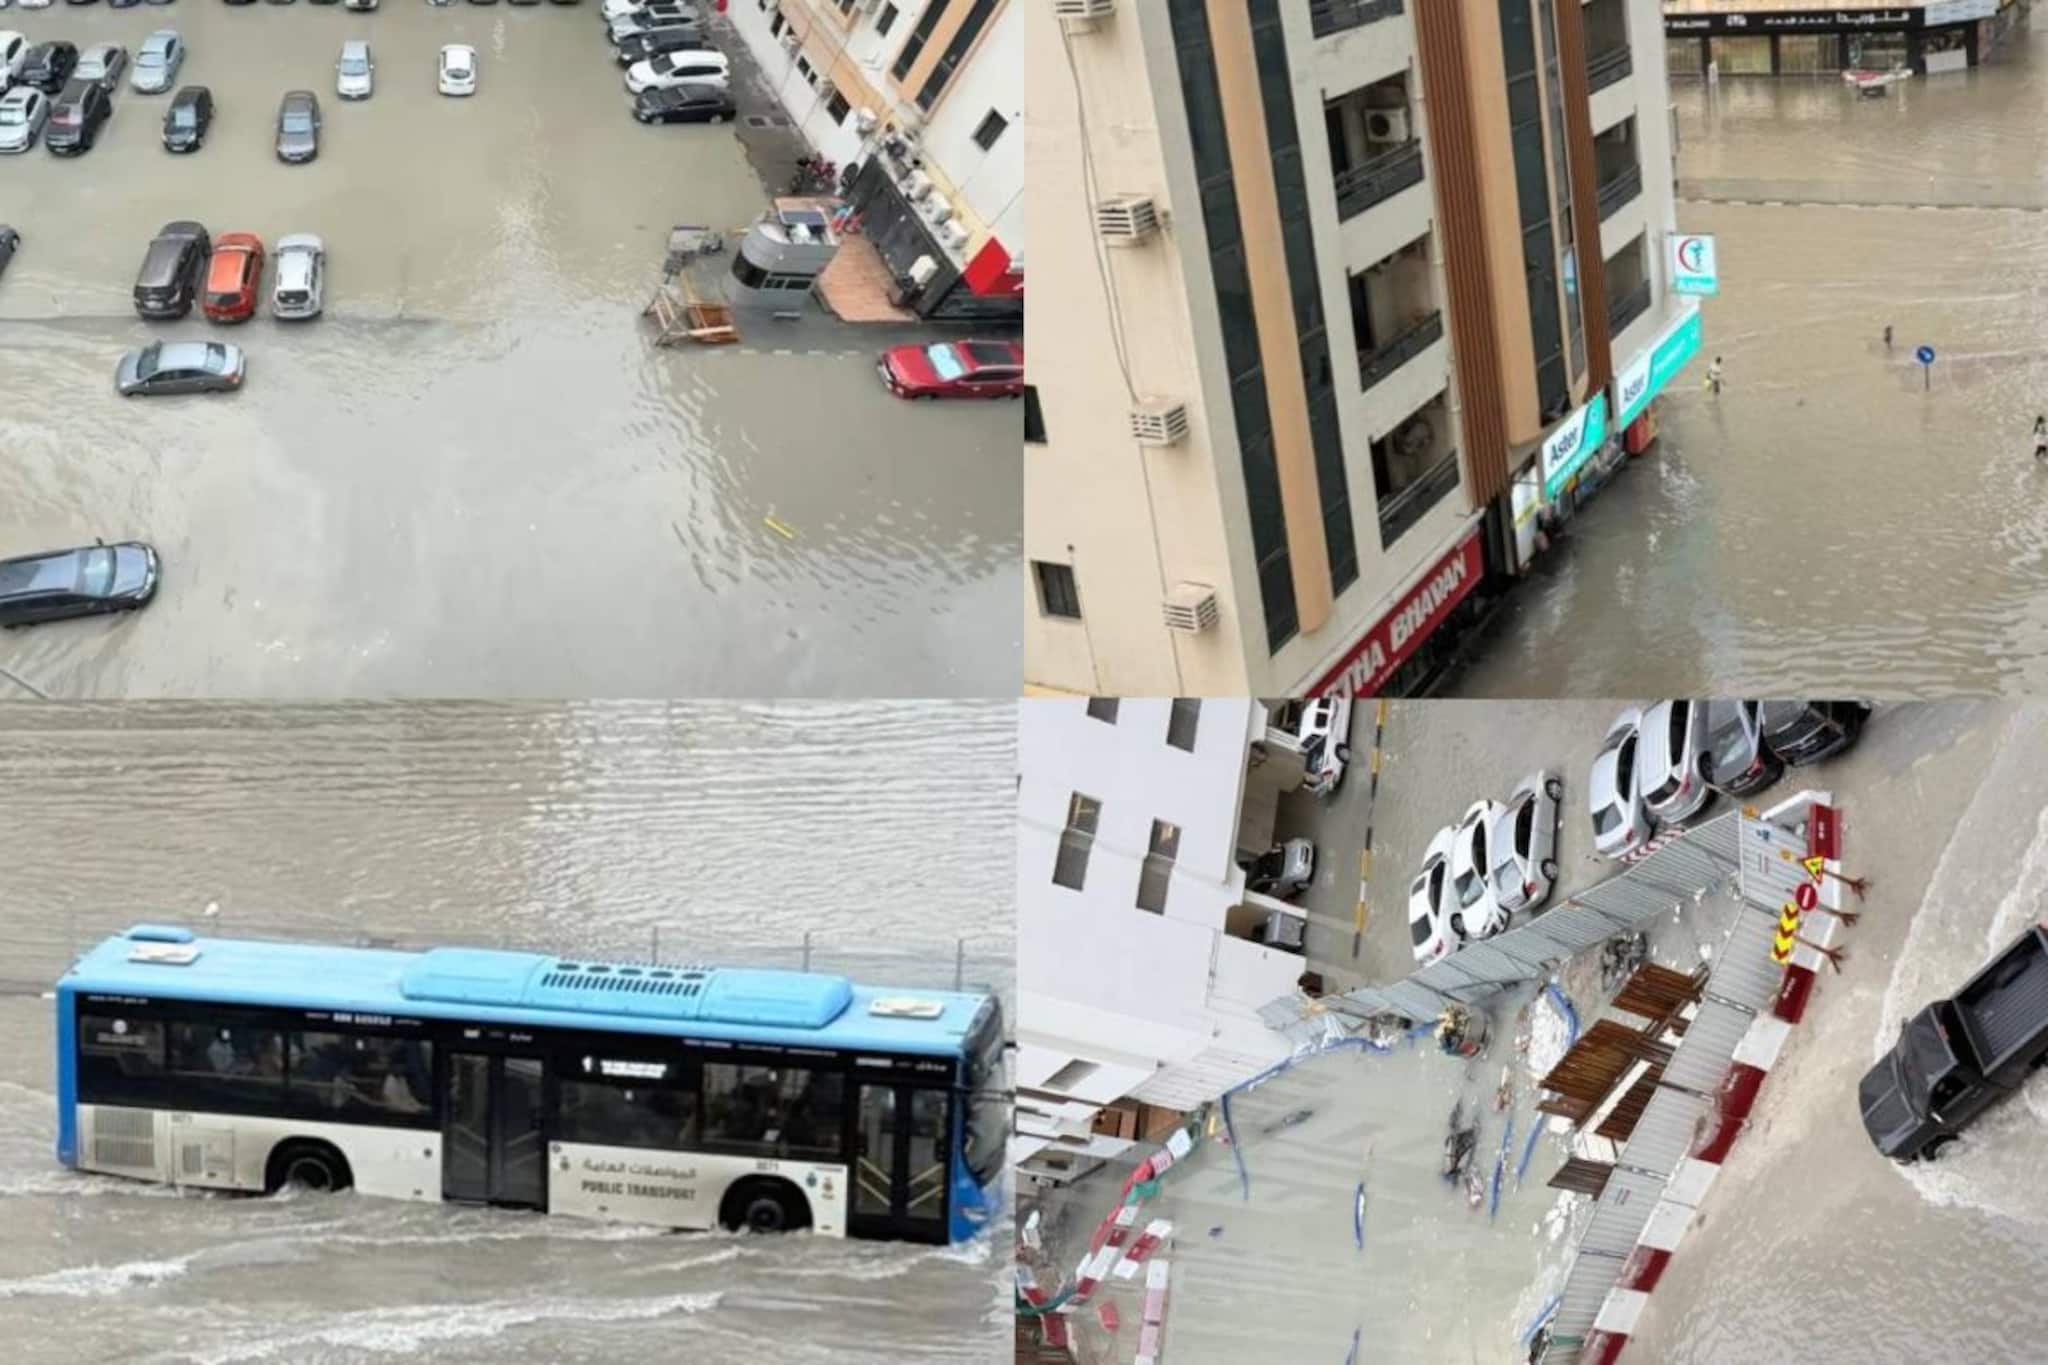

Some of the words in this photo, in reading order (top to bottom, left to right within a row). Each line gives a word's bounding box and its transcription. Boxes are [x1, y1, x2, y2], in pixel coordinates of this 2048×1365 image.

[1548, 426, 1578, 468] Aster
[1389, 550, 1468, 653] BHAVAN
[580, 1179, 624, 1196] PUBLIC
[626, 1182, 697, 1200] TRANSPORT
